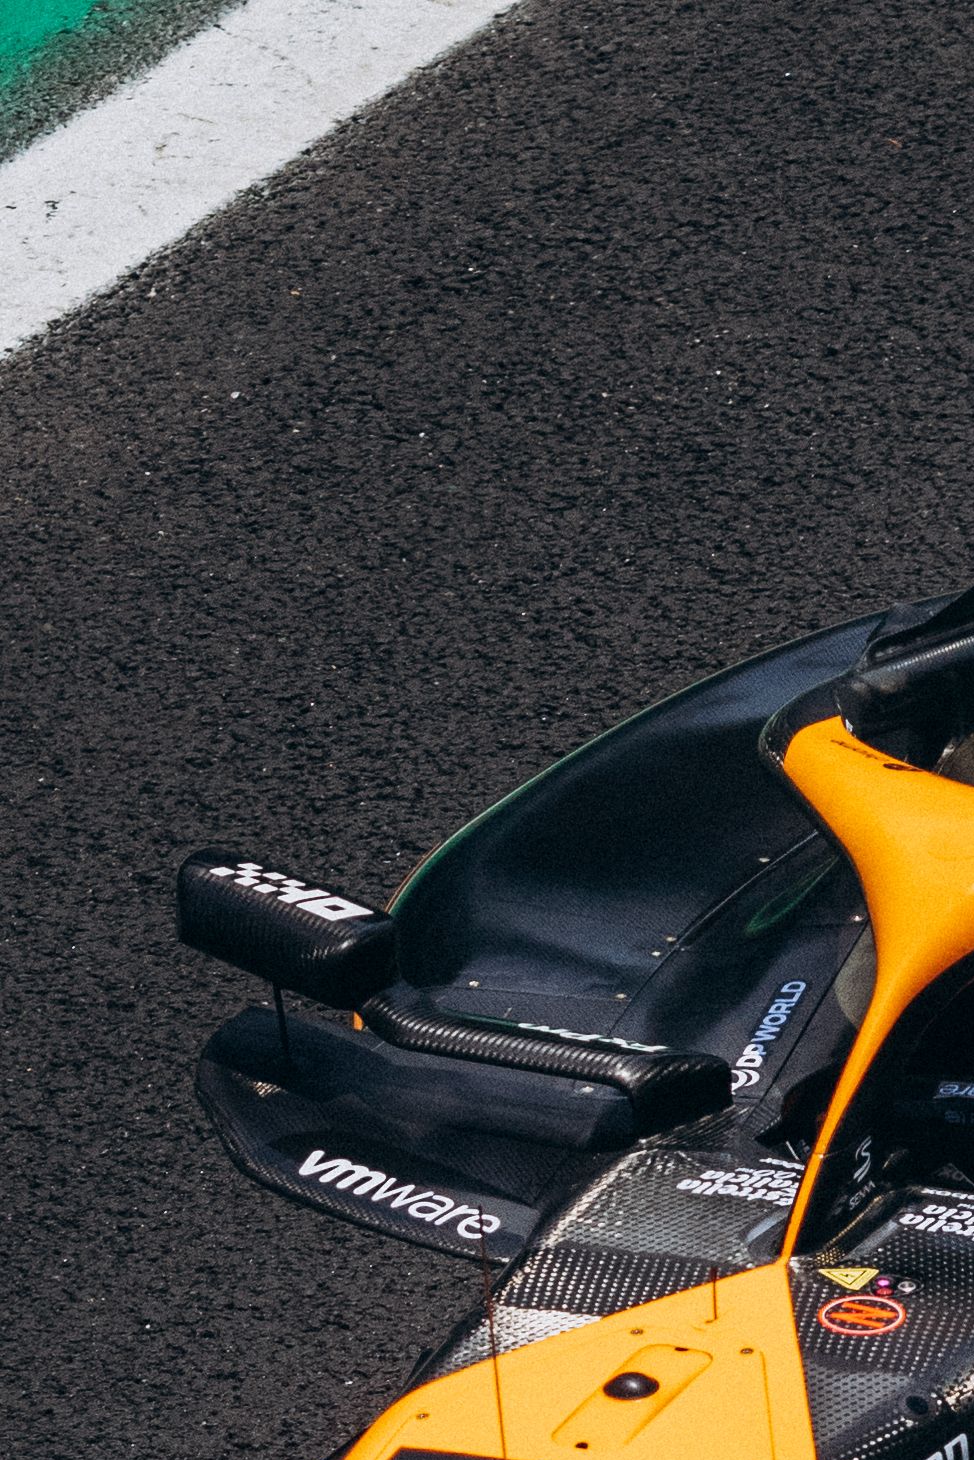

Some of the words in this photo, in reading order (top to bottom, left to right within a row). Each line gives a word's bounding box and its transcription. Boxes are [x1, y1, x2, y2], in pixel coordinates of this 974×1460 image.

[750, 981, 806, 1042] WORLD
[736, 1043, 767, 1068] DP
[298, 1149, 501, 1240] vmware
